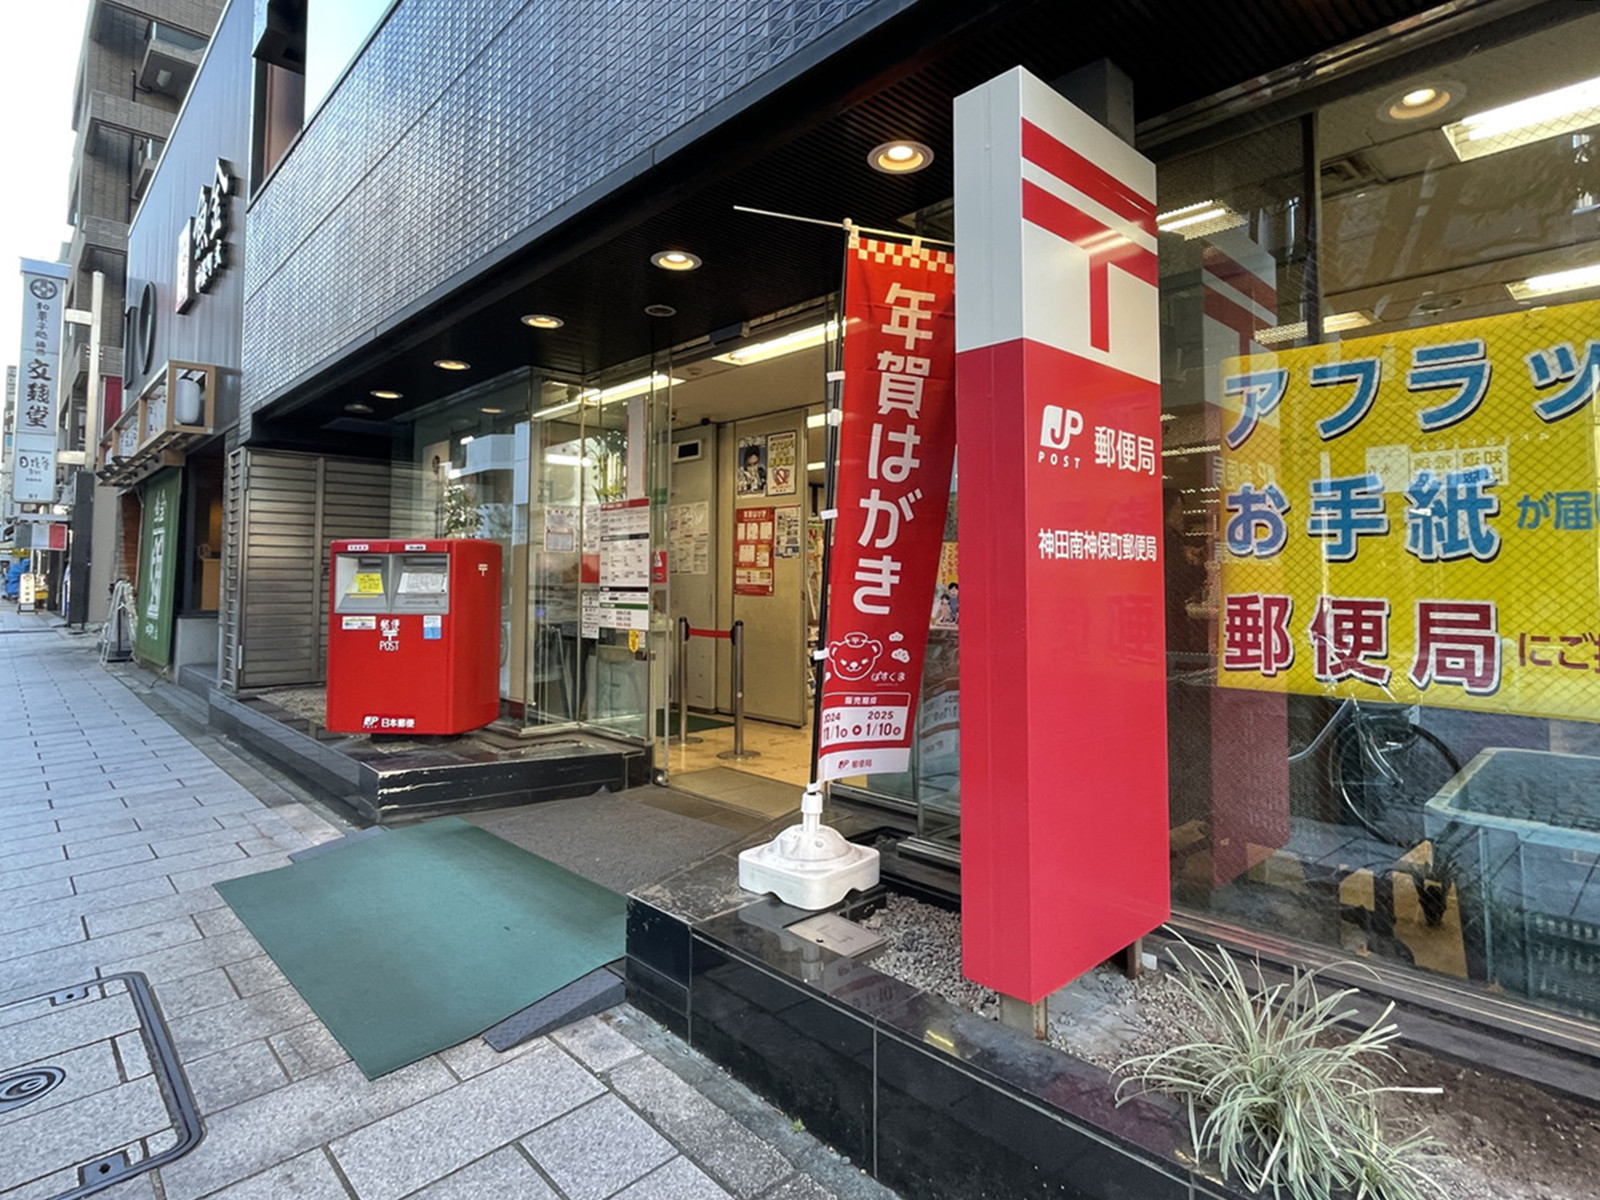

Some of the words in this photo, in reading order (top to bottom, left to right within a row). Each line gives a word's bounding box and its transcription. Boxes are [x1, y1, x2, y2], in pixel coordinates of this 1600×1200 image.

[853, 282, 936, 615] 年賀はがき
[1094, 426, 1156, 476] 郵便局
[1037, 450, 1081, 469] POST
[1038, 527, 1157, 562] 神田南神保町郵便局
[380, 619, 400, 631] 郵便
[379, 640, 399, 651] POST
[381, 718, 415, 728] 日本郵便
[867, 711, 894, 720] 2025
